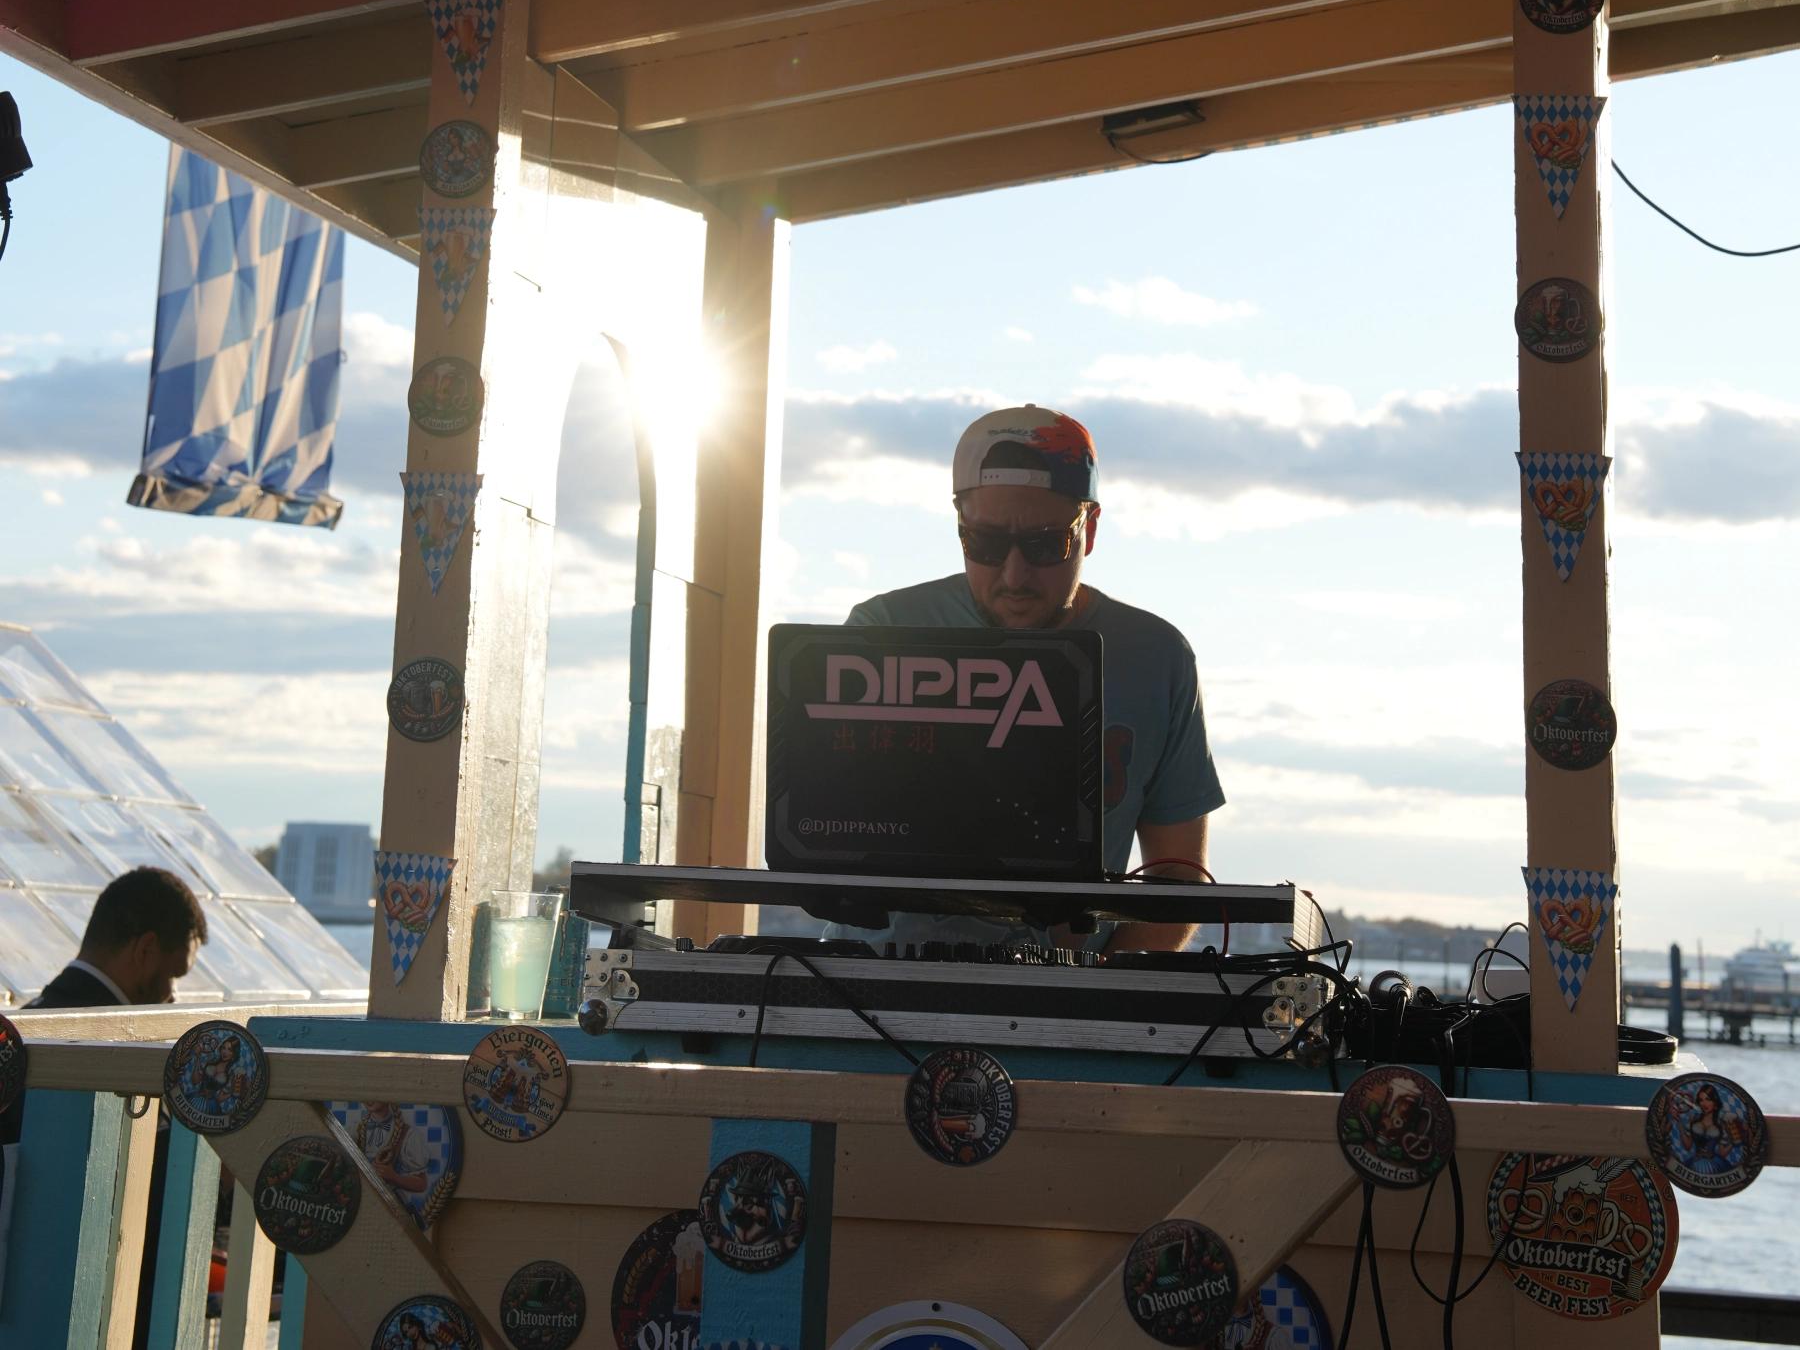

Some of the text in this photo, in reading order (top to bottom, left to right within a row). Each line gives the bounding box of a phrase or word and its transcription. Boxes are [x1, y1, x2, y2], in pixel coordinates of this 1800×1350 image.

[826, 654, 1065, 749] DIPPA
[1533, 723, 1609, 743] Oktoberfest
[798, 817, 910, 836] @DJDIPPANYC
[488, 1031, 563, 1078] Biergarten
[175, 1094, 226, 1127] BIERGARTEN
[979, 1058, 1013, 1154] OKTOBERFEST
[483, 1118, 512, 1139] Prost!
[1352, 1146, 1416, 1180] Oktoberfest
[1674, 1163, 1742, 1186] BIERGARTEN
[259, 1185, 347, 1226] Oktoberfest
[726, 1242, 779, 1259] Oktoberfest
[1506, 1237, 1628, 1281] Oktoberfest
[1136, 1273, 1232, 1321] Oktoberfest
[1513, 1272, 1611, 1316] BEER FEST
[1556, 1273, 1590, 1294] BEST
[505, 1307, 579, 1329] Oktoberfest
